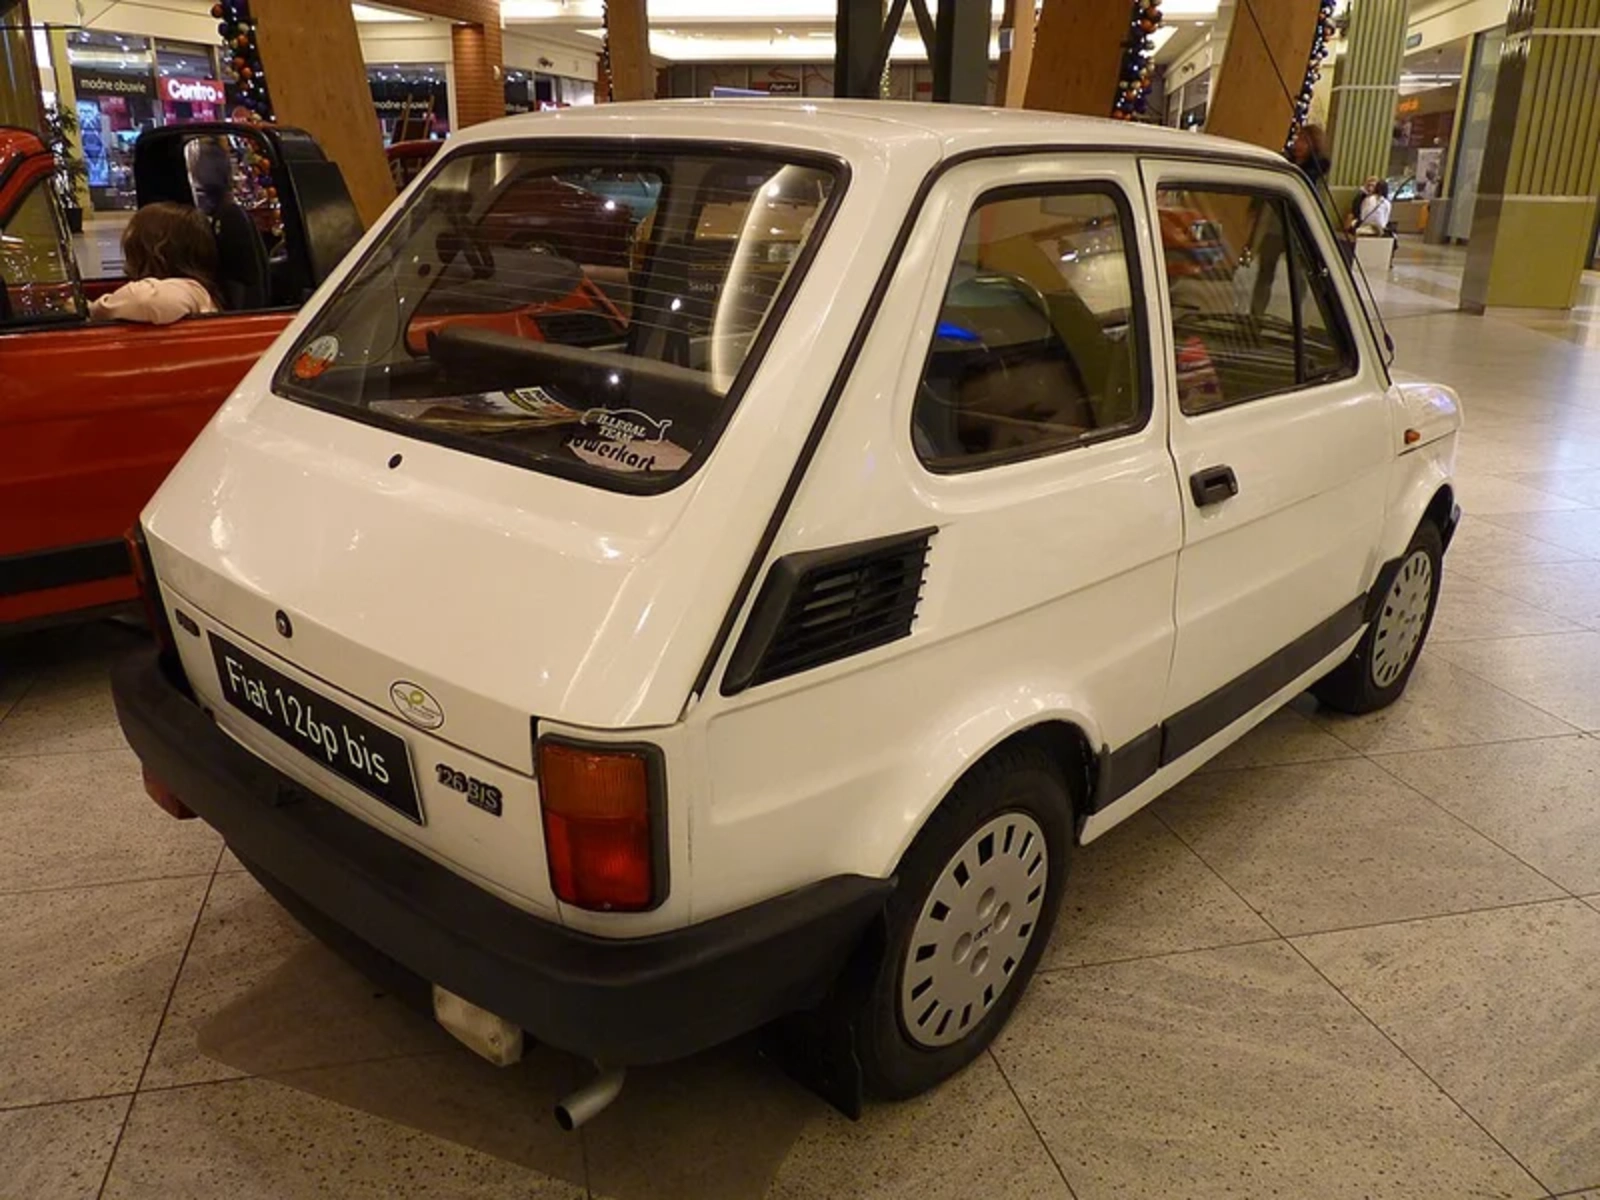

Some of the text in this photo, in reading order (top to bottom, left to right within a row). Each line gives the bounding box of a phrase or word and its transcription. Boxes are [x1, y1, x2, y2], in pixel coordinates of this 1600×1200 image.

[80, 77, 146, 92] modne obuwie
[167, 79, 216, 102] Centro
[597, 413, 646, 437] ILLEGAL
[225, 655, 390, 784] Fiat 126p bis
[436, 764, 501, 810] 126 BIS
